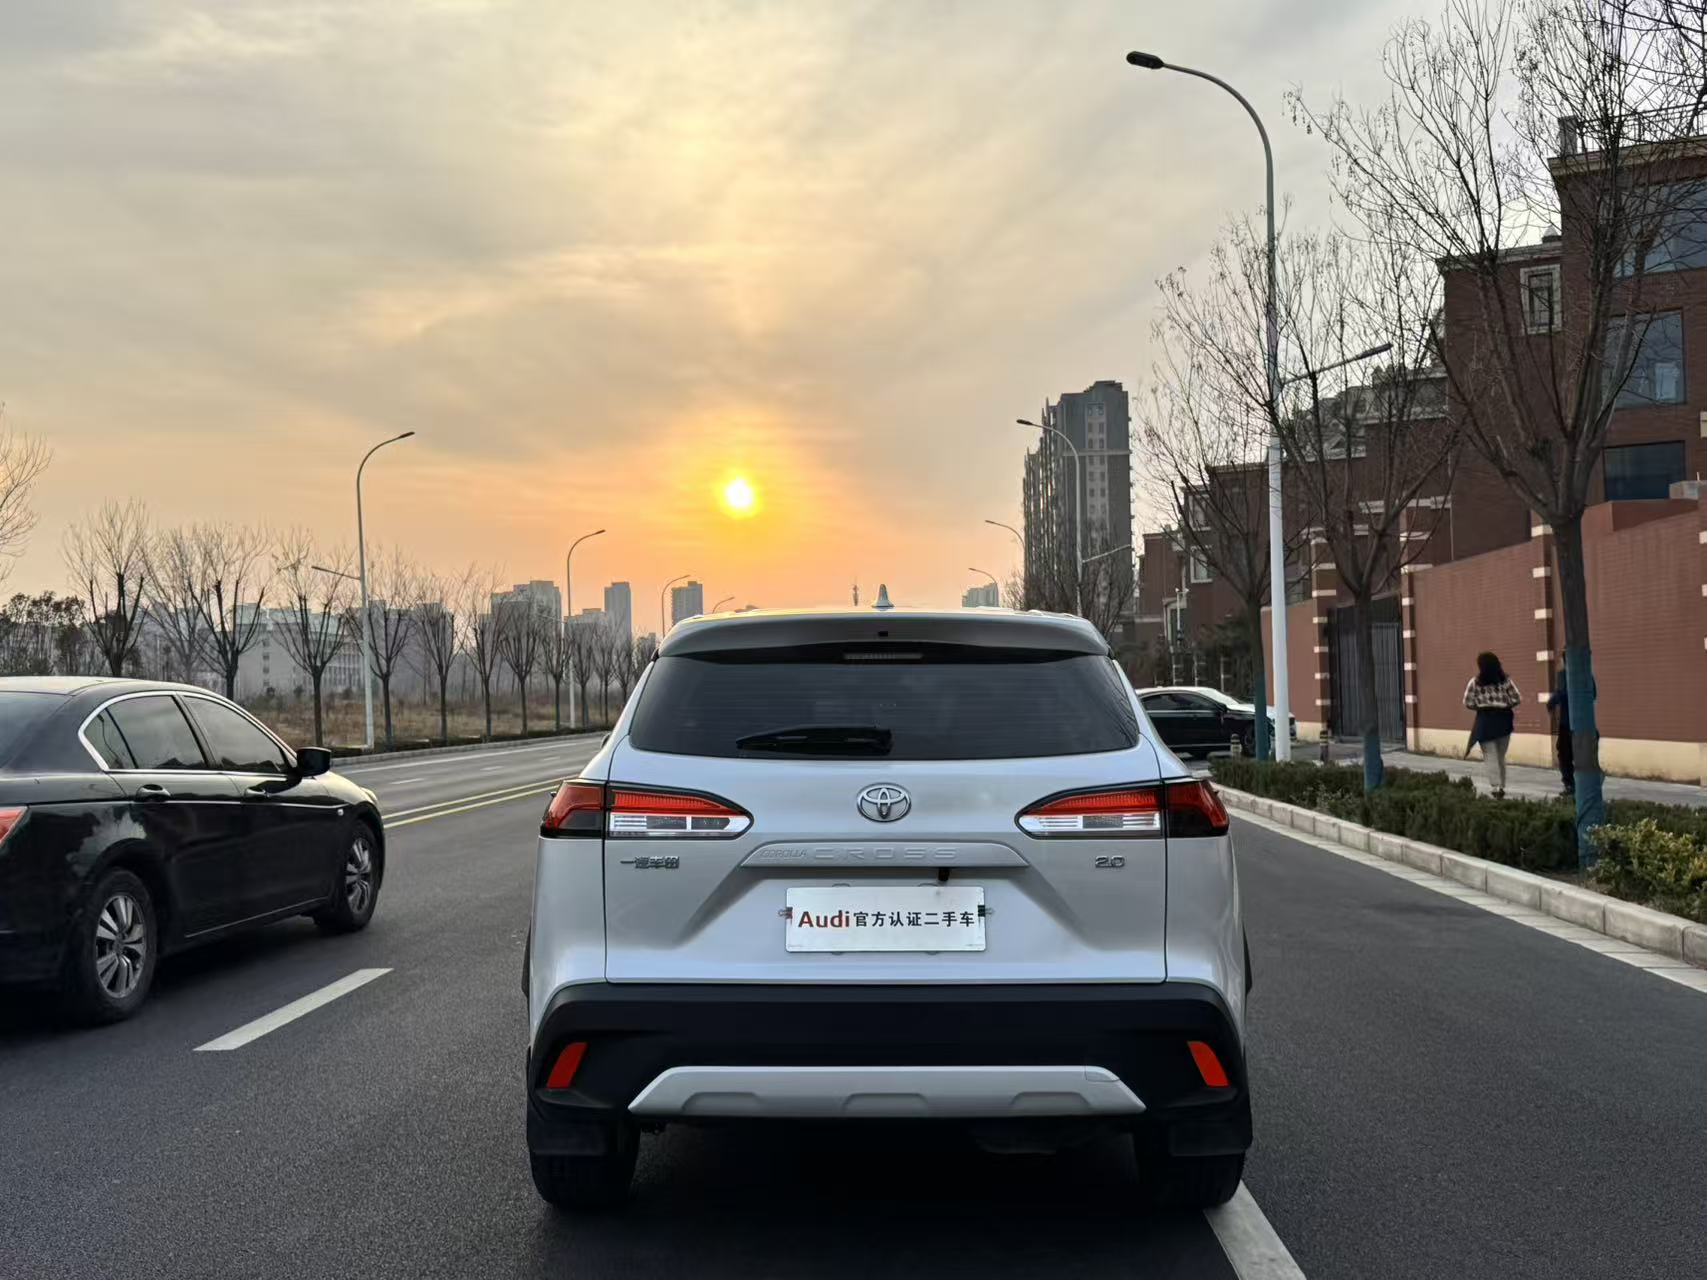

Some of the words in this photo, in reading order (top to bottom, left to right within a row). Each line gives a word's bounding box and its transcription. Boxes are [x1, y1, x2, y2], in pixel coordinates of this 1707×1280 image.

[815, 848, 959, 859] CROSS
[798, 909, 850, 928] Audi
[853, 911, 975, 927] 官方认证二手车
